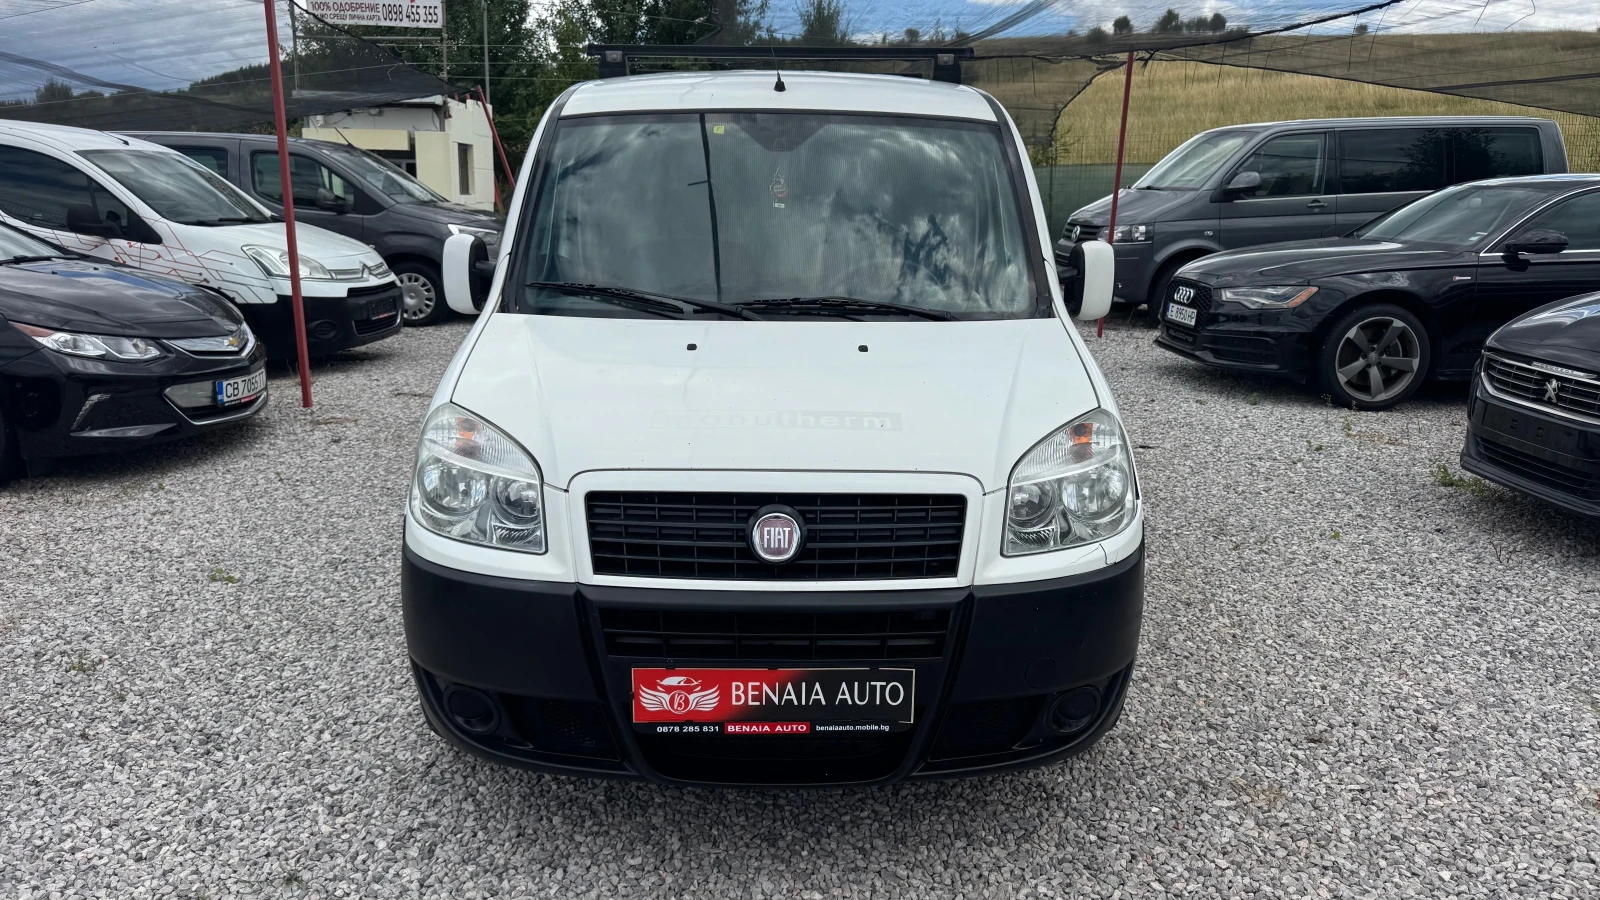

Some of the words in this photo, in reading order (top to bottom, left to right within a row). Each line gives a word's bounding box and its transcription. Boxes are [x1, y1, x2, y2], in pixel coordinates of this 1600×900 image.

[311, 1, 331, 12] 100%
[332, 2, 380, 13] ОДОБРЕНИЕ
[382, 3, 403, 22] 0898
[405, 4, 421, 23] 455
[423, 5, 438, 23] 355
[225, 382, 240, 398] CB
[241, 375, 258, 395] 7055
[763, 527, 791, 549] FIAT
[731, 681, 826, 706] BENAIA
[835, 681, 905, 706] AUTO
[656, 725, 680, 733] 0878
[682, 725, 700, 733] 285
[727, 724, 771, 732] BENAIA
[775, 724, 807, 732] AUTO
[815, 723, 890, 733] benaiaauto.mobile.bg
